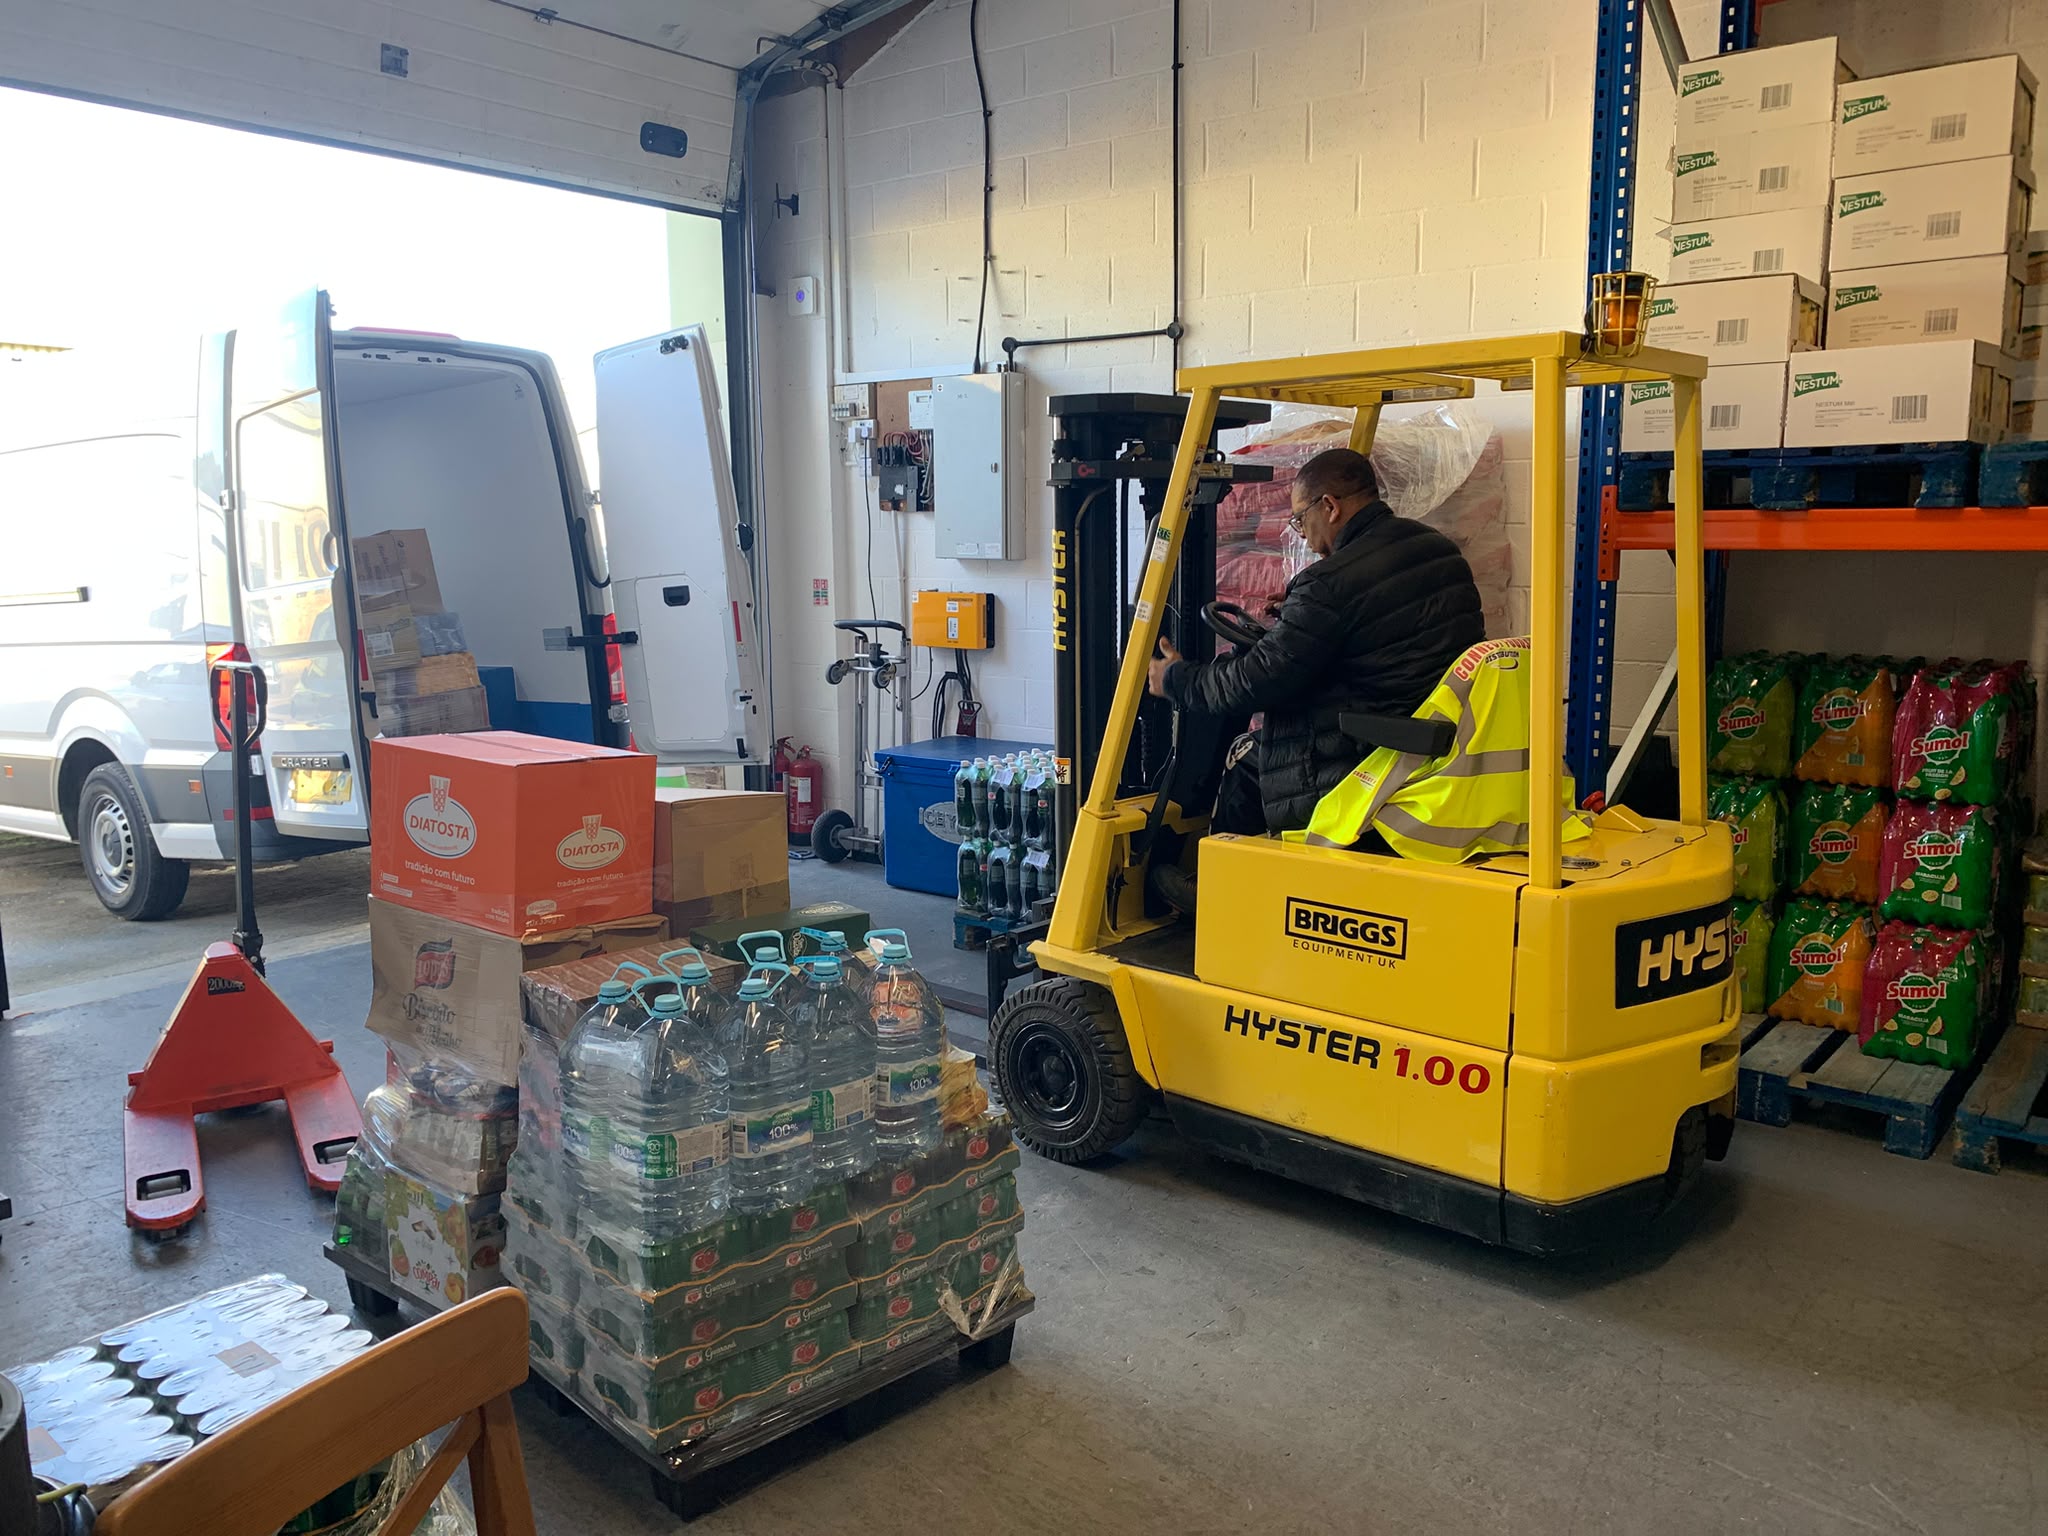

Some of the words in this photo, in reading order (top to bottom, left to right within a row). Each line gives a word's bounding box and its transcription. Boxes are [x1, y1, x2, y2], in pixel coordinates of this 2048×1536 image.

[1682, 74, 1722, 92] NESTUM
[1843, 99, 1888, 118] NESTUM
[1677, 154, 1717, 173] NESTUM
[1840, 194, 1884, 213] NESTUM
[1673, 235, 1712, 254] NESTUM
[1835, 287, 1879, 307] NESTUM
[1630, 386, 1671, 400] NESTUM
[1793, 375, 1840, 393] NESTUM
[1052, 528, 1067, 652] HYSTER
[1718, 710, 1766, 732] Sumol
[1811, 701, 1865, 722] Sumol
[1910, 731, 1970, 756] Sumol
[280, 757, 330, 768] CRAFTER
[409, 815, 470, 841] DIATOSTA
[562, 841, 620, 858] DIATOSTA
[1809, 837, 1859, 854] Sumol
[1903, 839, 1962, 859] Sumol
[405, 860, 433, 876] tradição
[434, 868, 451, 880] com
[452, 870, 475, 886] futuro
[557, 877, 585, 888] tradição
[603, 872, 624, 882] futuro
[1294, 908, 1397, 947] BRIGGS
[1292, 939, 1374, 964] EQUIPMENT
[1378, 956, 1396, 969] UK
[1791, 948, 1843, 966] Sumol
[1886, 981, 1946, 1000] Sumol
[1223, 1004, 1381, 1070] HYSTER
[1392, 1046, 1492, 1094] 1.00
[908, 1077, 933, 1092] 100%
[768, 1122, 799, 1140] 100%
[614, 1142, 637, 1160] 100%
